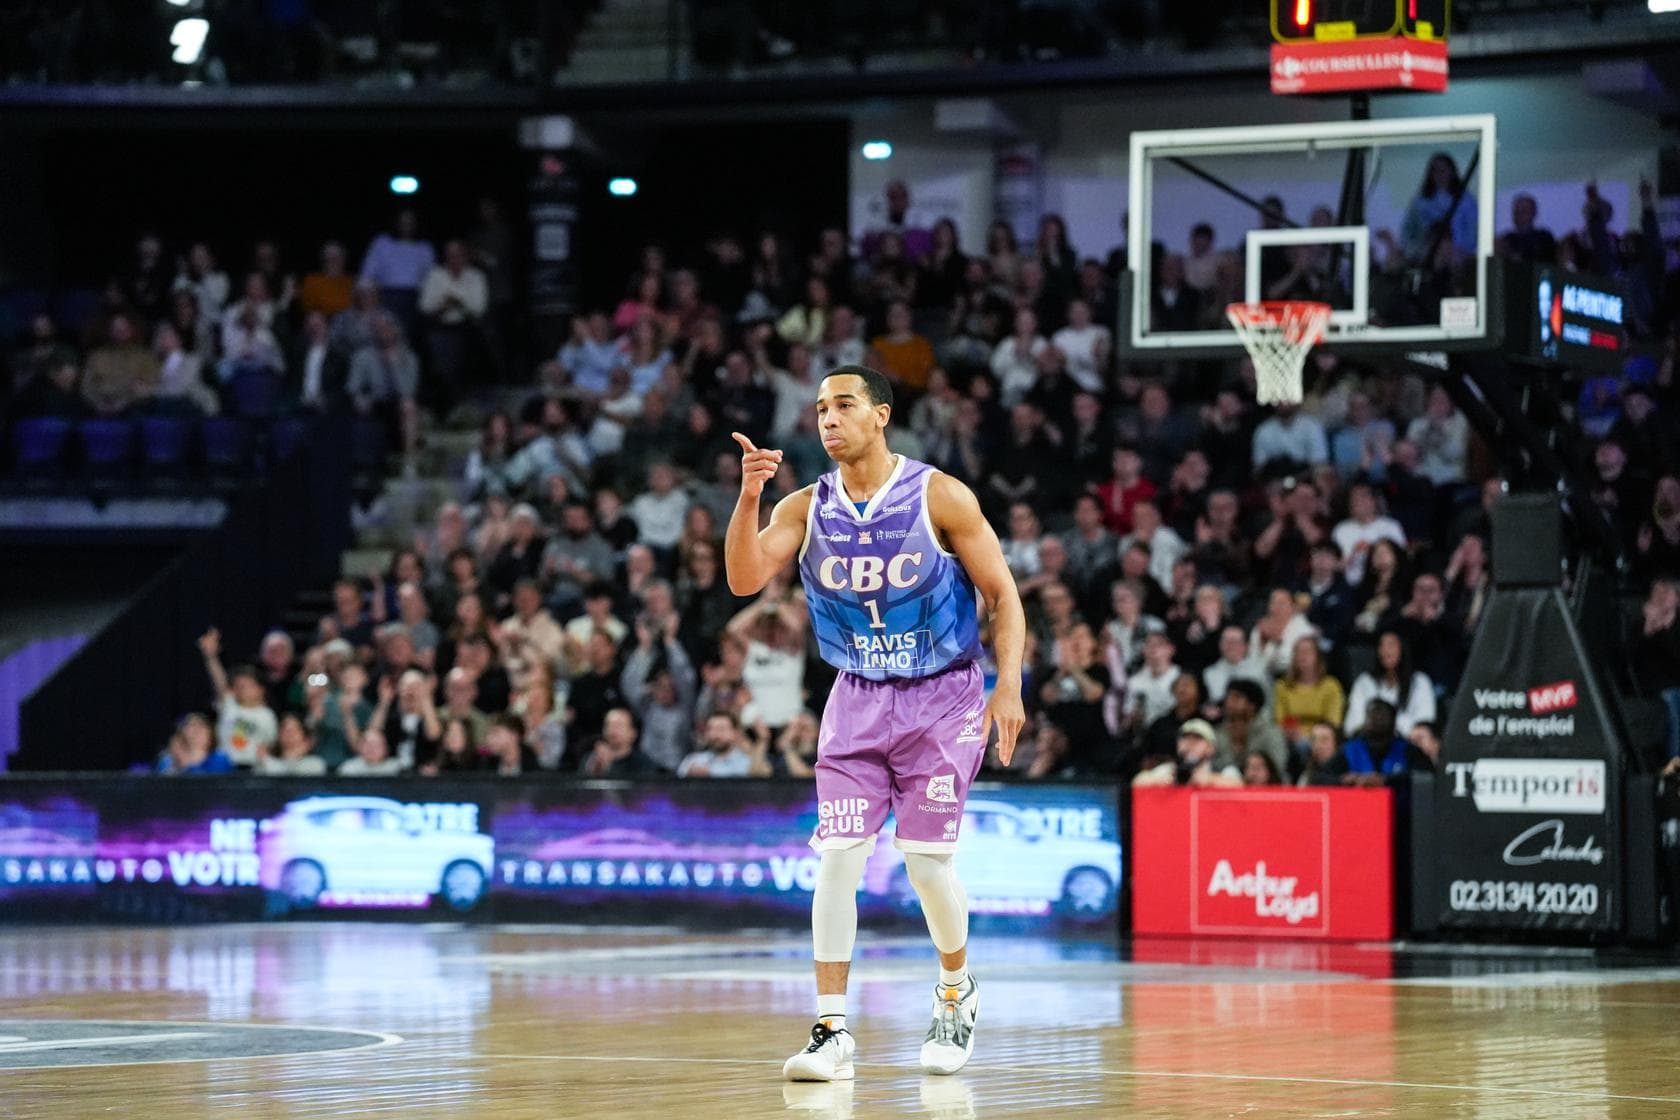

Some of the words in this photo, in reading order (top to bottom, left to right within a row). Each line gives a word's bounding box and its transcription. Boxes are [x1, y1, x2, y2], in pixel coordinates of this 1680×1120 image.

[819, 552, 922, 592] CBC
[863, 599, 887, 629] 1
[1468, 715, 1495, 736] de
[1446, 761, 1600, 803] Temporis
[820, 798, 869, 819] QUIP
[819, 815, 865, 837] CLUB
[502, 860, 764, 888] TRANSAKAUTO
